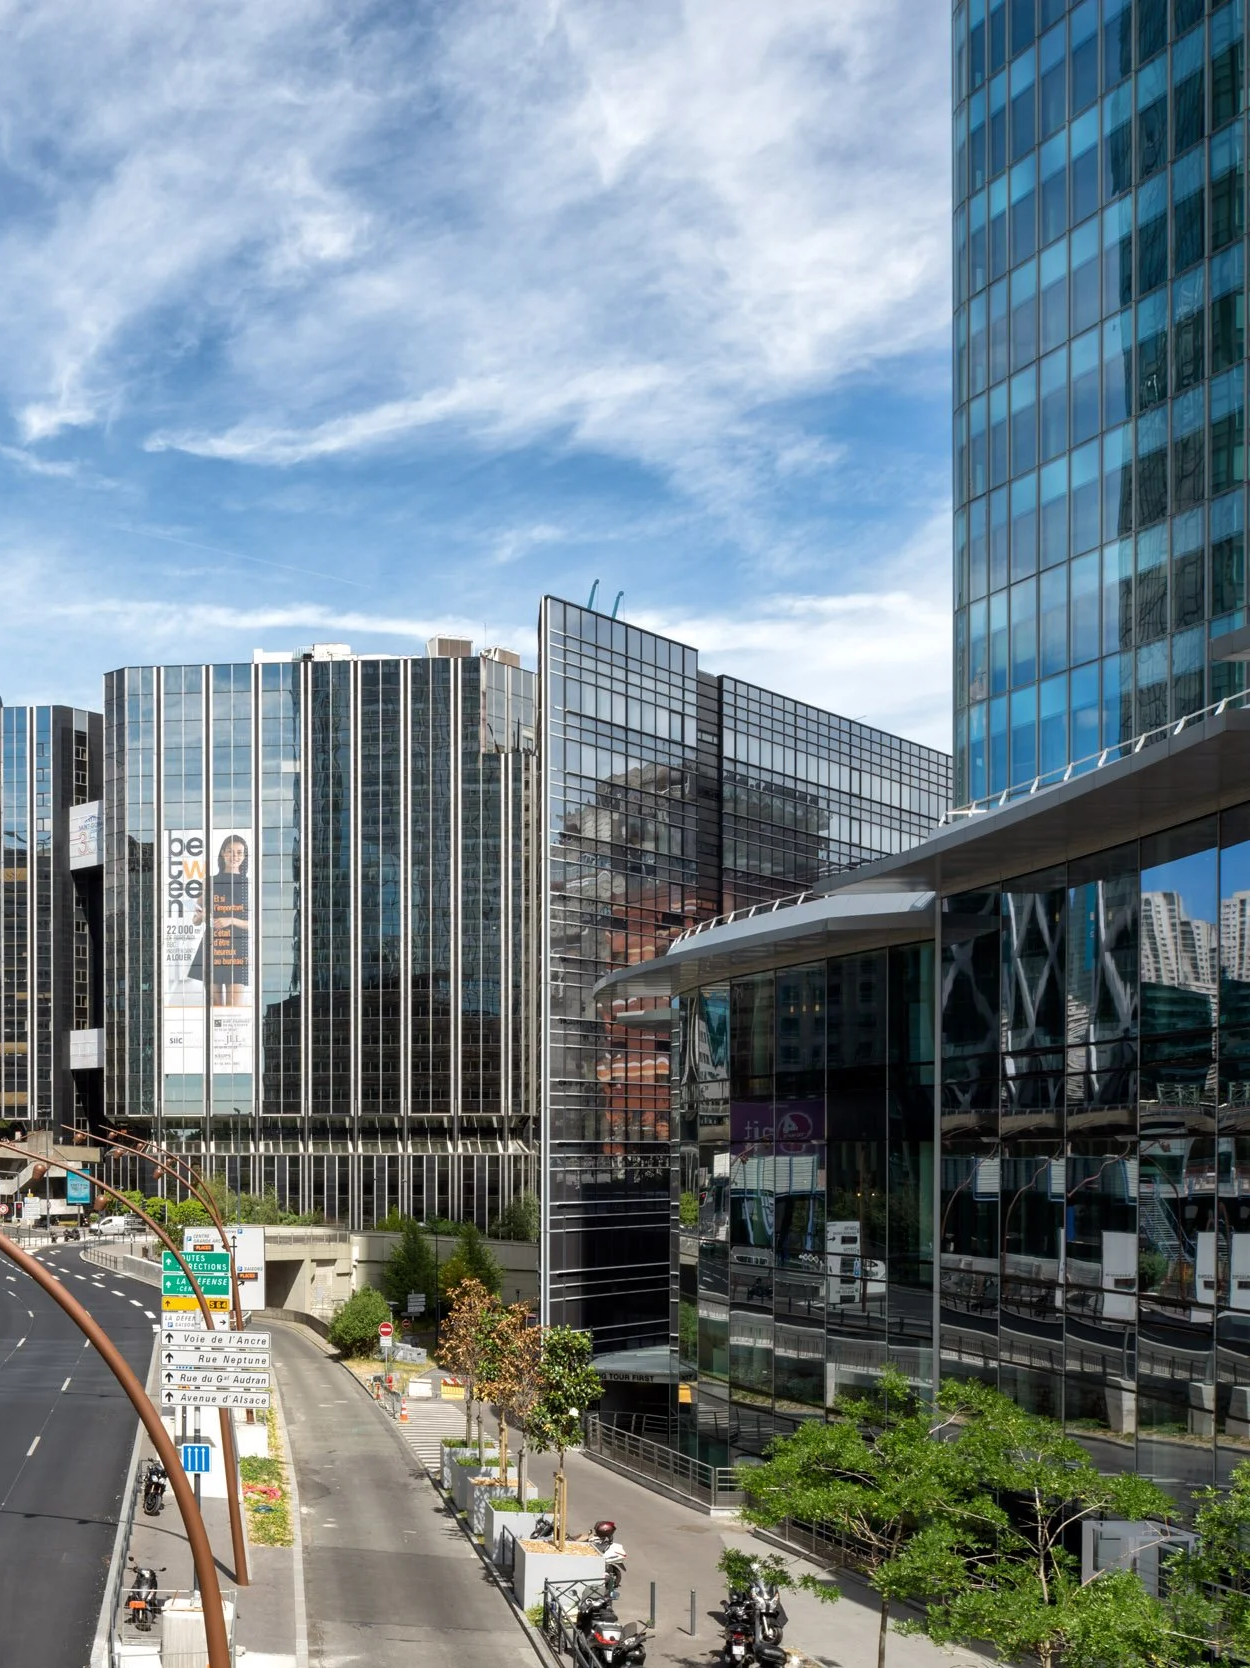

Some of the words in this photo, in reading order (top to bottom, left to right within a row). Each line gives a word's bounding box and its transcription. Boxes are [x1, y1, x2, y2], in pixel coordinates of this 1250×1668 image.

[168, 829, 203, 857] be
[166, 925, 177, 935] 22
[178, 925, 194, 935] 000
[176, 1277, 187, 1285] LA
[196, 1276, 228, 1286] ÉFENSE
[184, 1334, 205, 1343] Voie
[211, 1336, 223, 1344] de
[228, 1336, 267, 1346] l'Ancre
[198, 1354, 218, 1363] Rue
[223, 1355, 267, 1366] Neptune
[180, 1373, 198, 1383] Rue
[201, 1374, 213, 1383] du
[233, 1375, 267, 1385] Audran
[610, 1373, 630, 1381] TOUR
[632, 1374, 655, 1382] FIRST
[180, 1393, 217, 1403] Avenue
[222, 1394, 267, 1405] d'Alsace
